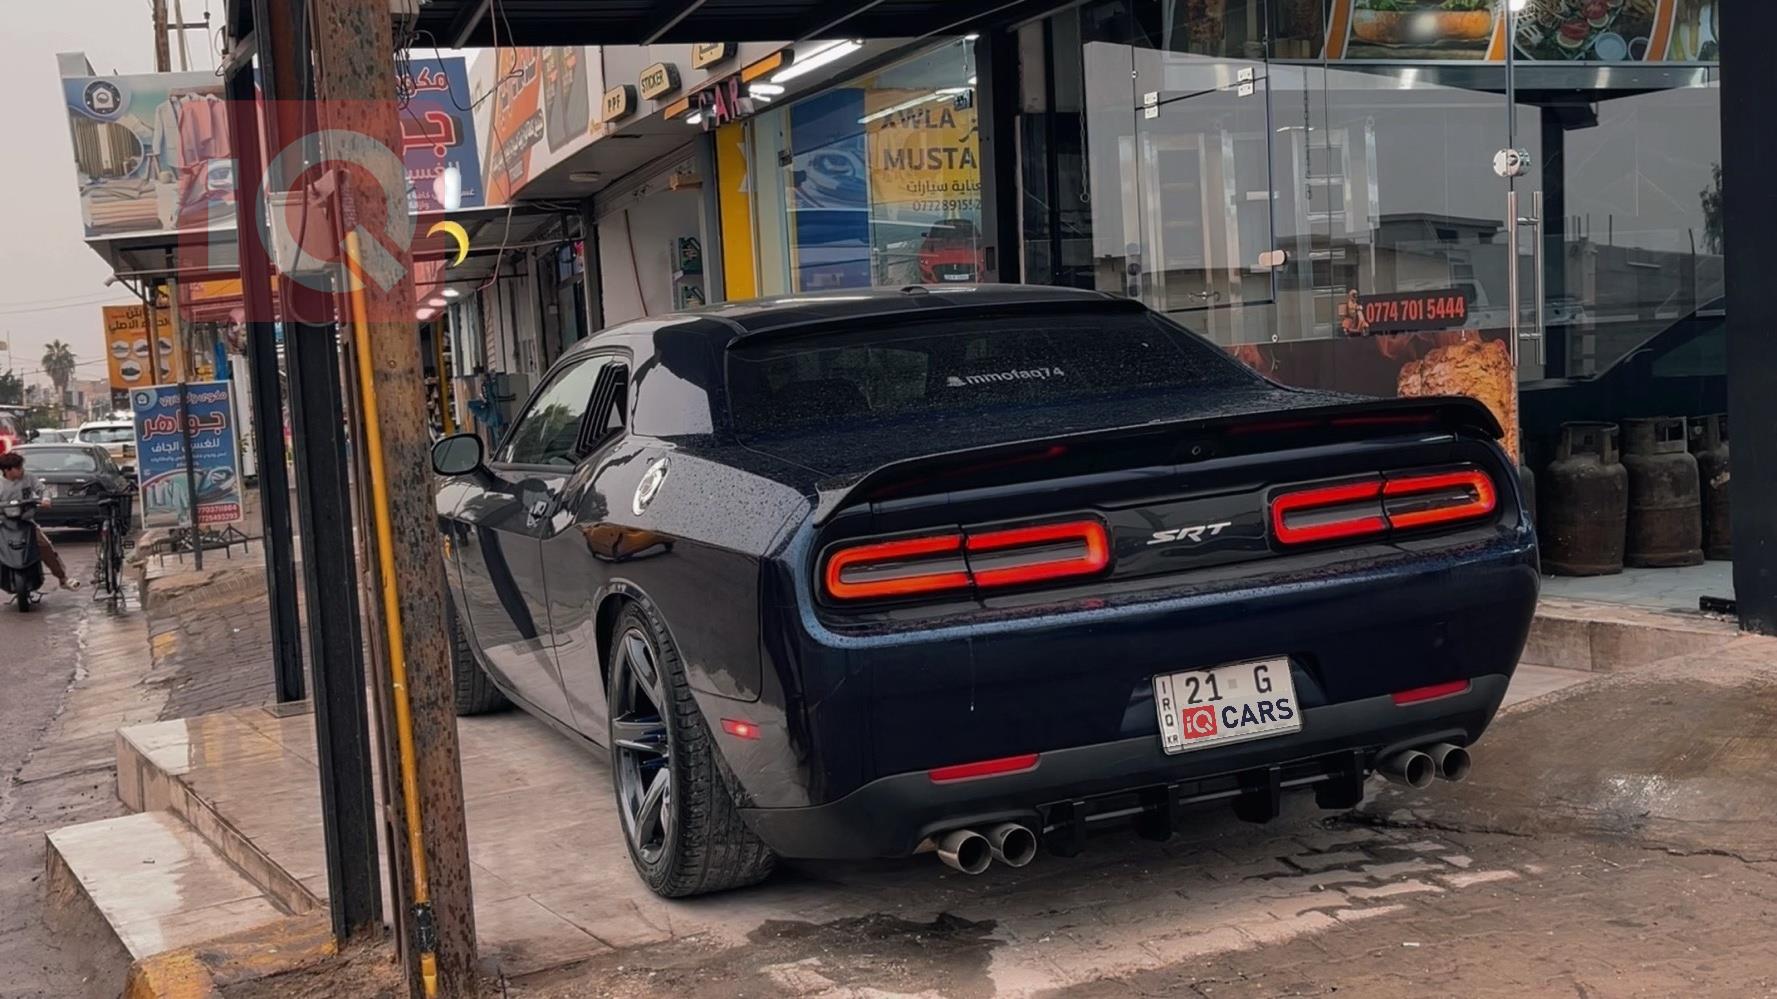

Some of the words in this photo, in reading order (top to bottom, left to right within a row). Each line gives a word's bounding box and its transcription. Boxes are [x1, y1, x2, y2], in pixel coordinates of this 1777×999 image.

[395, 67, 449, 98] مكو
[641, 69, 664, 94] STICKER
[607, 95, 620, 113] PPF
[884, 147, 978, 171] MUSTA
[1366, 301, 1399, 323] 0774
[1401, 298, 1424, 321] 701
[1427, 296, 1465, 319] 5444
[1146, 521, 1232, 546] SRT
[1185, 673, 1223, 704] 21
[1254, 664, 1273, 694] G
[1167, 734, 1179, 744] KR
